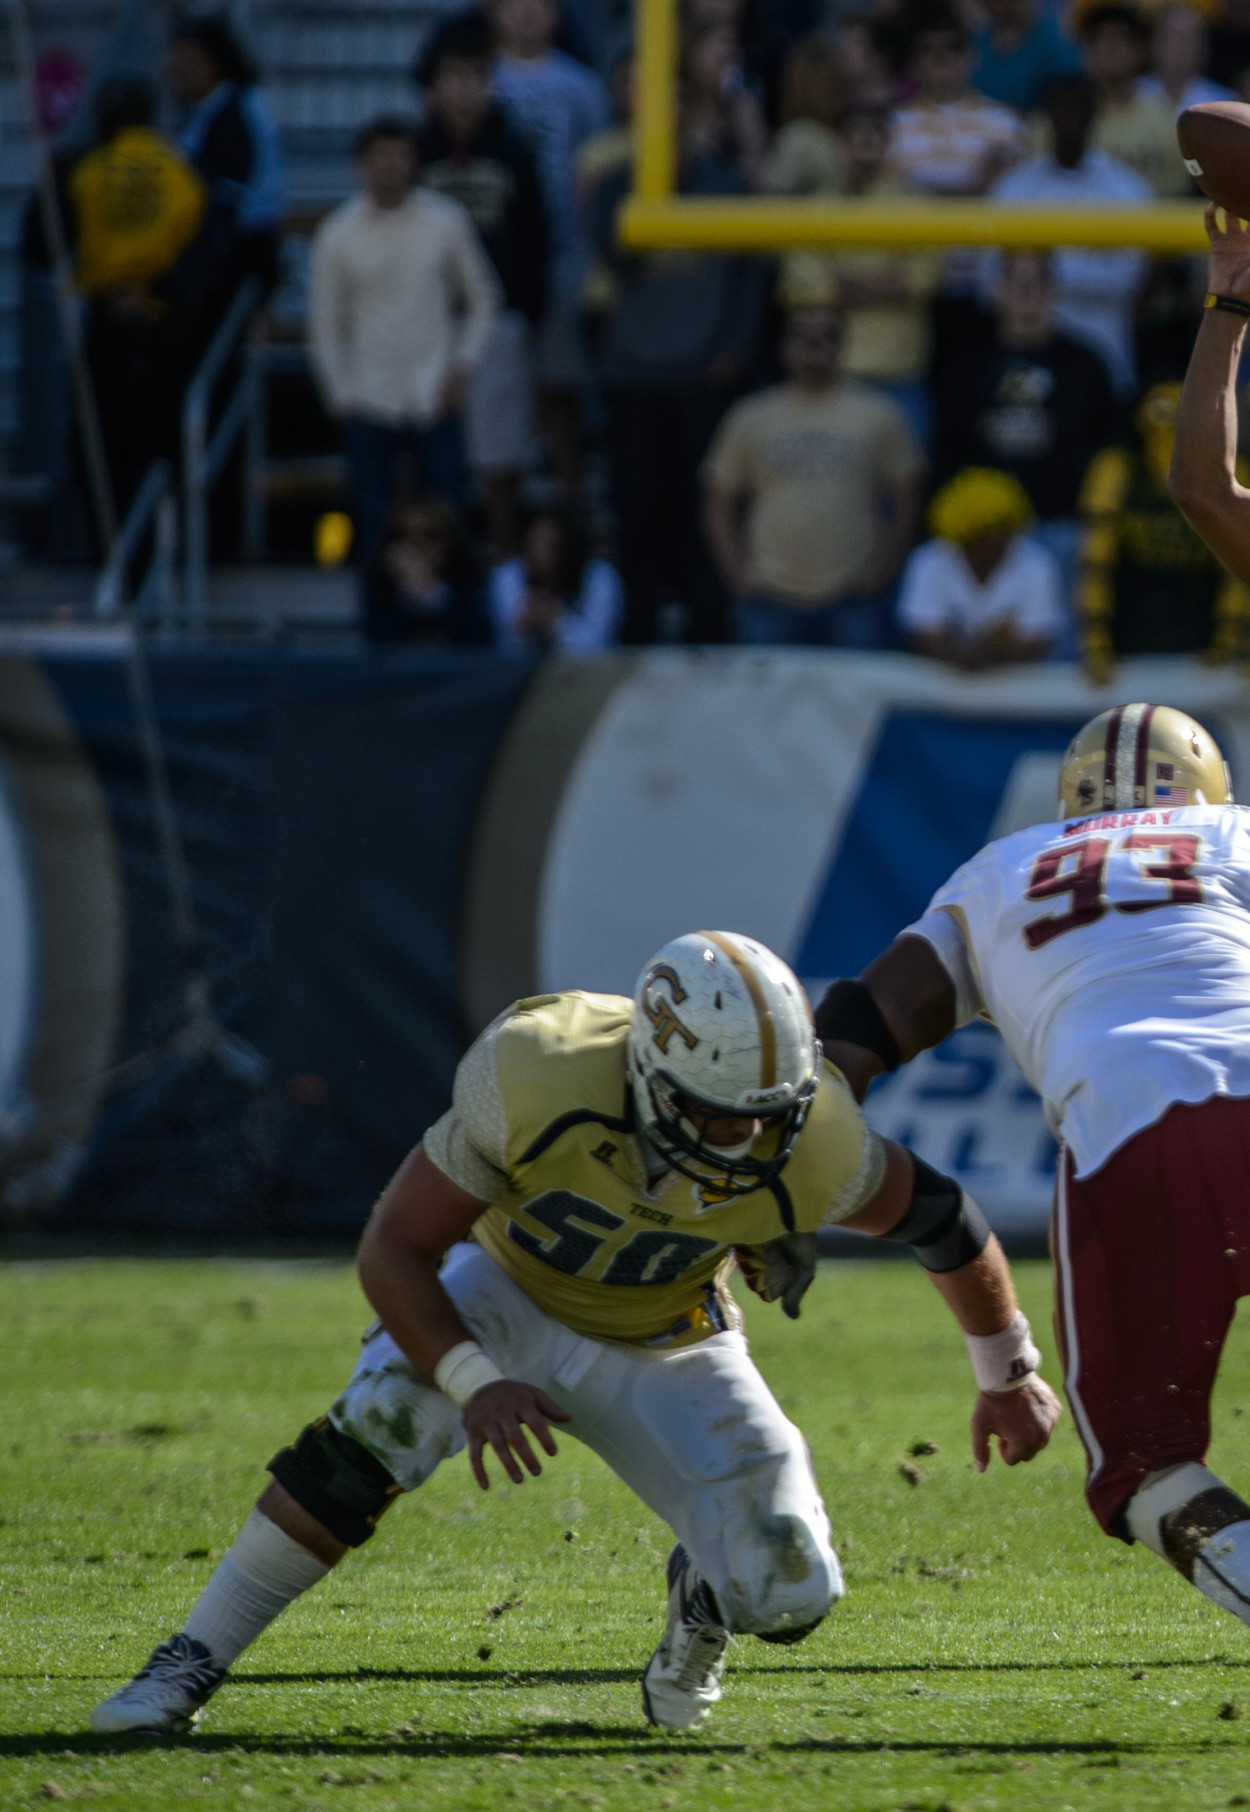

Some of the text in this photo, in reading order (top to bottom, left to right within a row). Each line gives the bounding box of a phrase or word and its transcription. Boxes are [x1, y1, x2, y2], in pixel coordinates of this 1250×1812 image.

[1062, 810, 1174, 838] MURRAY
[1023, 832, 1206, 951] 93
[505, 1188, 724, 1287] 50
[628, 1203, 674, 1226] TECH
